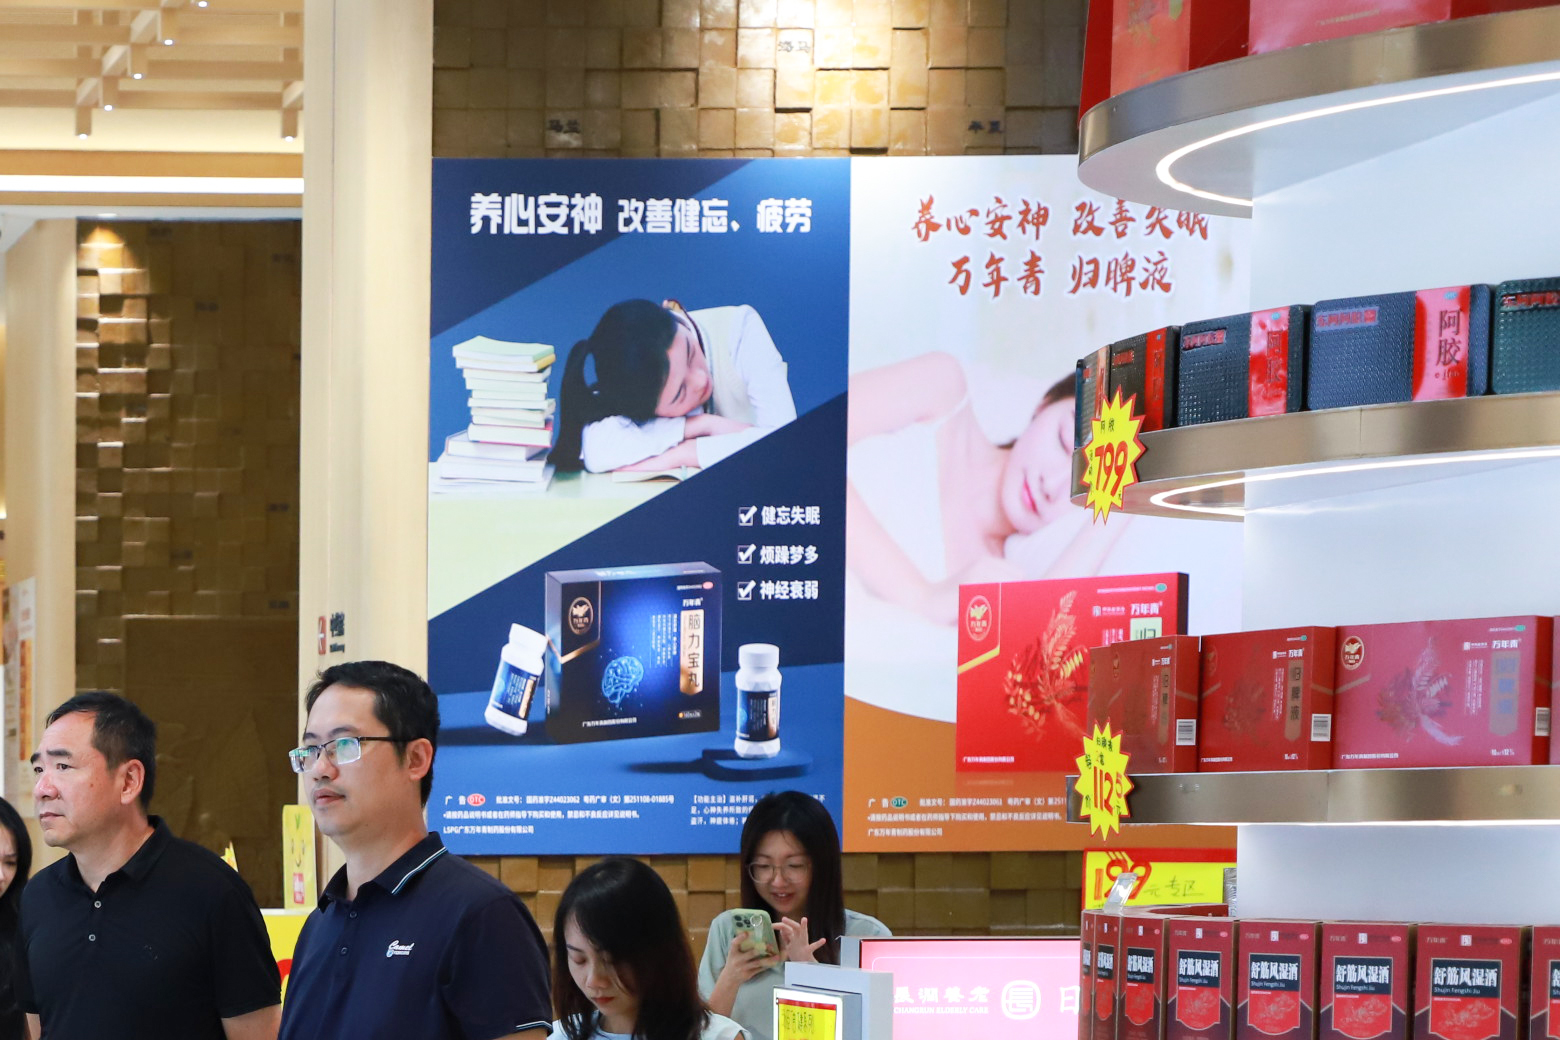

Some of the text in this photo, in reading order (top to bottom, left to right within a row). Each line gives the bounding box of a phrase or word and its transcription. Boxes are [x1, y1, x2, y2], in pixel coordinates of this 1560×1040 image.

[471, 193, 602, 234] 养心安神
[912, 195, 1210, 242] 养心安神 改善失眠
[948, 250, 1172, 297] 万年青 归脾液
[1436, 308, 1462, 367] 阿胶
[761, 506, 820, 525] 健忘失眠
[760, 545, 819, 564] 烦躁梦多
[760, 581, 819, 600] 神经衰弱
[688, 614, 701, 687] 脑力宝丸
[1094, 765, 1113, 816] 112
[389, 940, 414, 950] Camel
[1179, 957, 1219, 977] 舒筋风湿酒
[1251, 961, 1298, 980] 舒筋风湿酒
[1335, 964, 1390, 984] 舒筋风湿酒
[1434, 967, 1498, 988] 舒筋风湿酒
